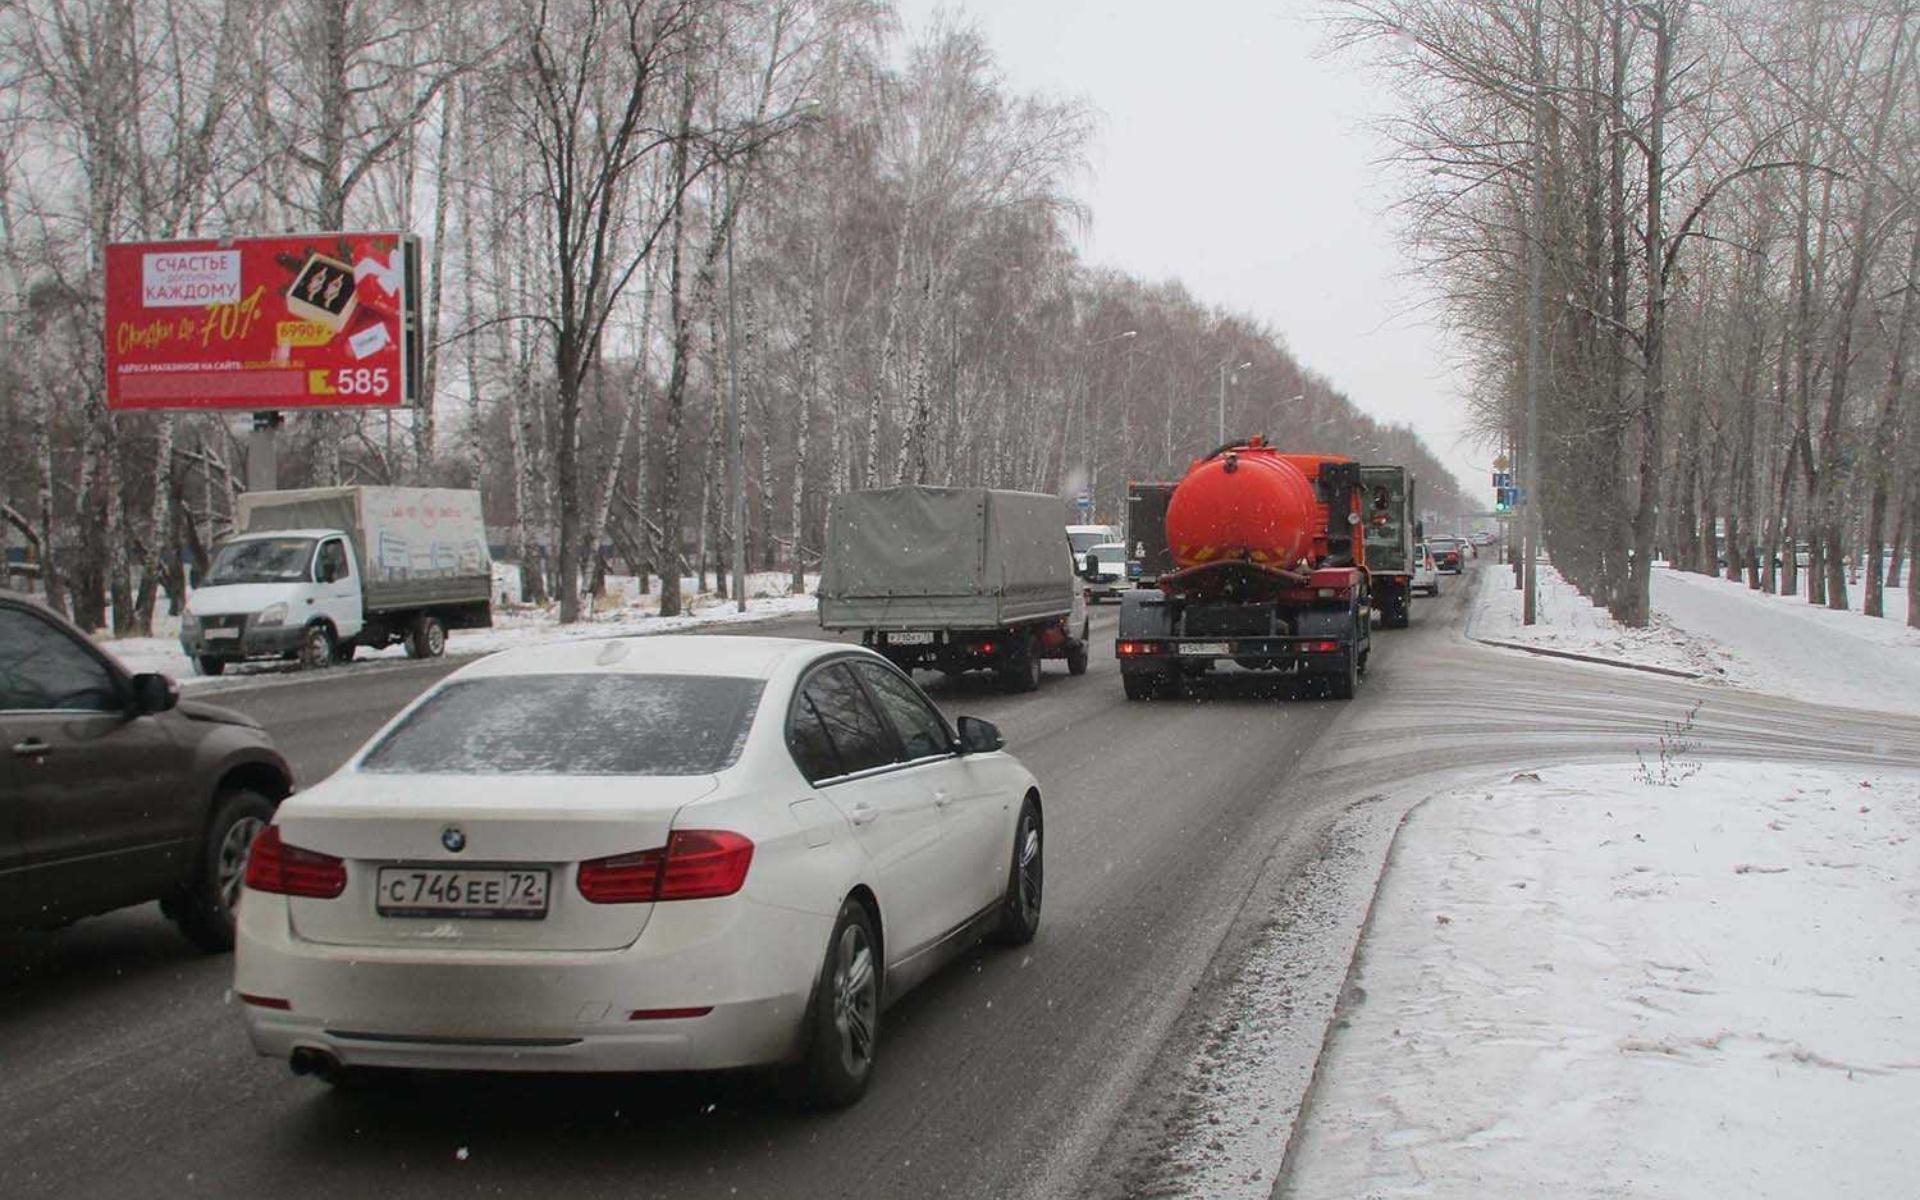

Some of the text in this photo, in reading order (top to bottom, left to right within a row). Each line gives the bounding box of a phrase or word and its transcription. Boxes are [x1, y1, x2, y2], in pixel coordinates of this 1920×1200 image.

[155, 255, 229, 272] СЧАСТЬЕ
[145, 282, 239, 300] КАЖДОМУ
[201, 284, 265, 348] 70%
[338, 368, 389, 394] 585
[390, 873, 536, 904] С746ЕЕ 72
